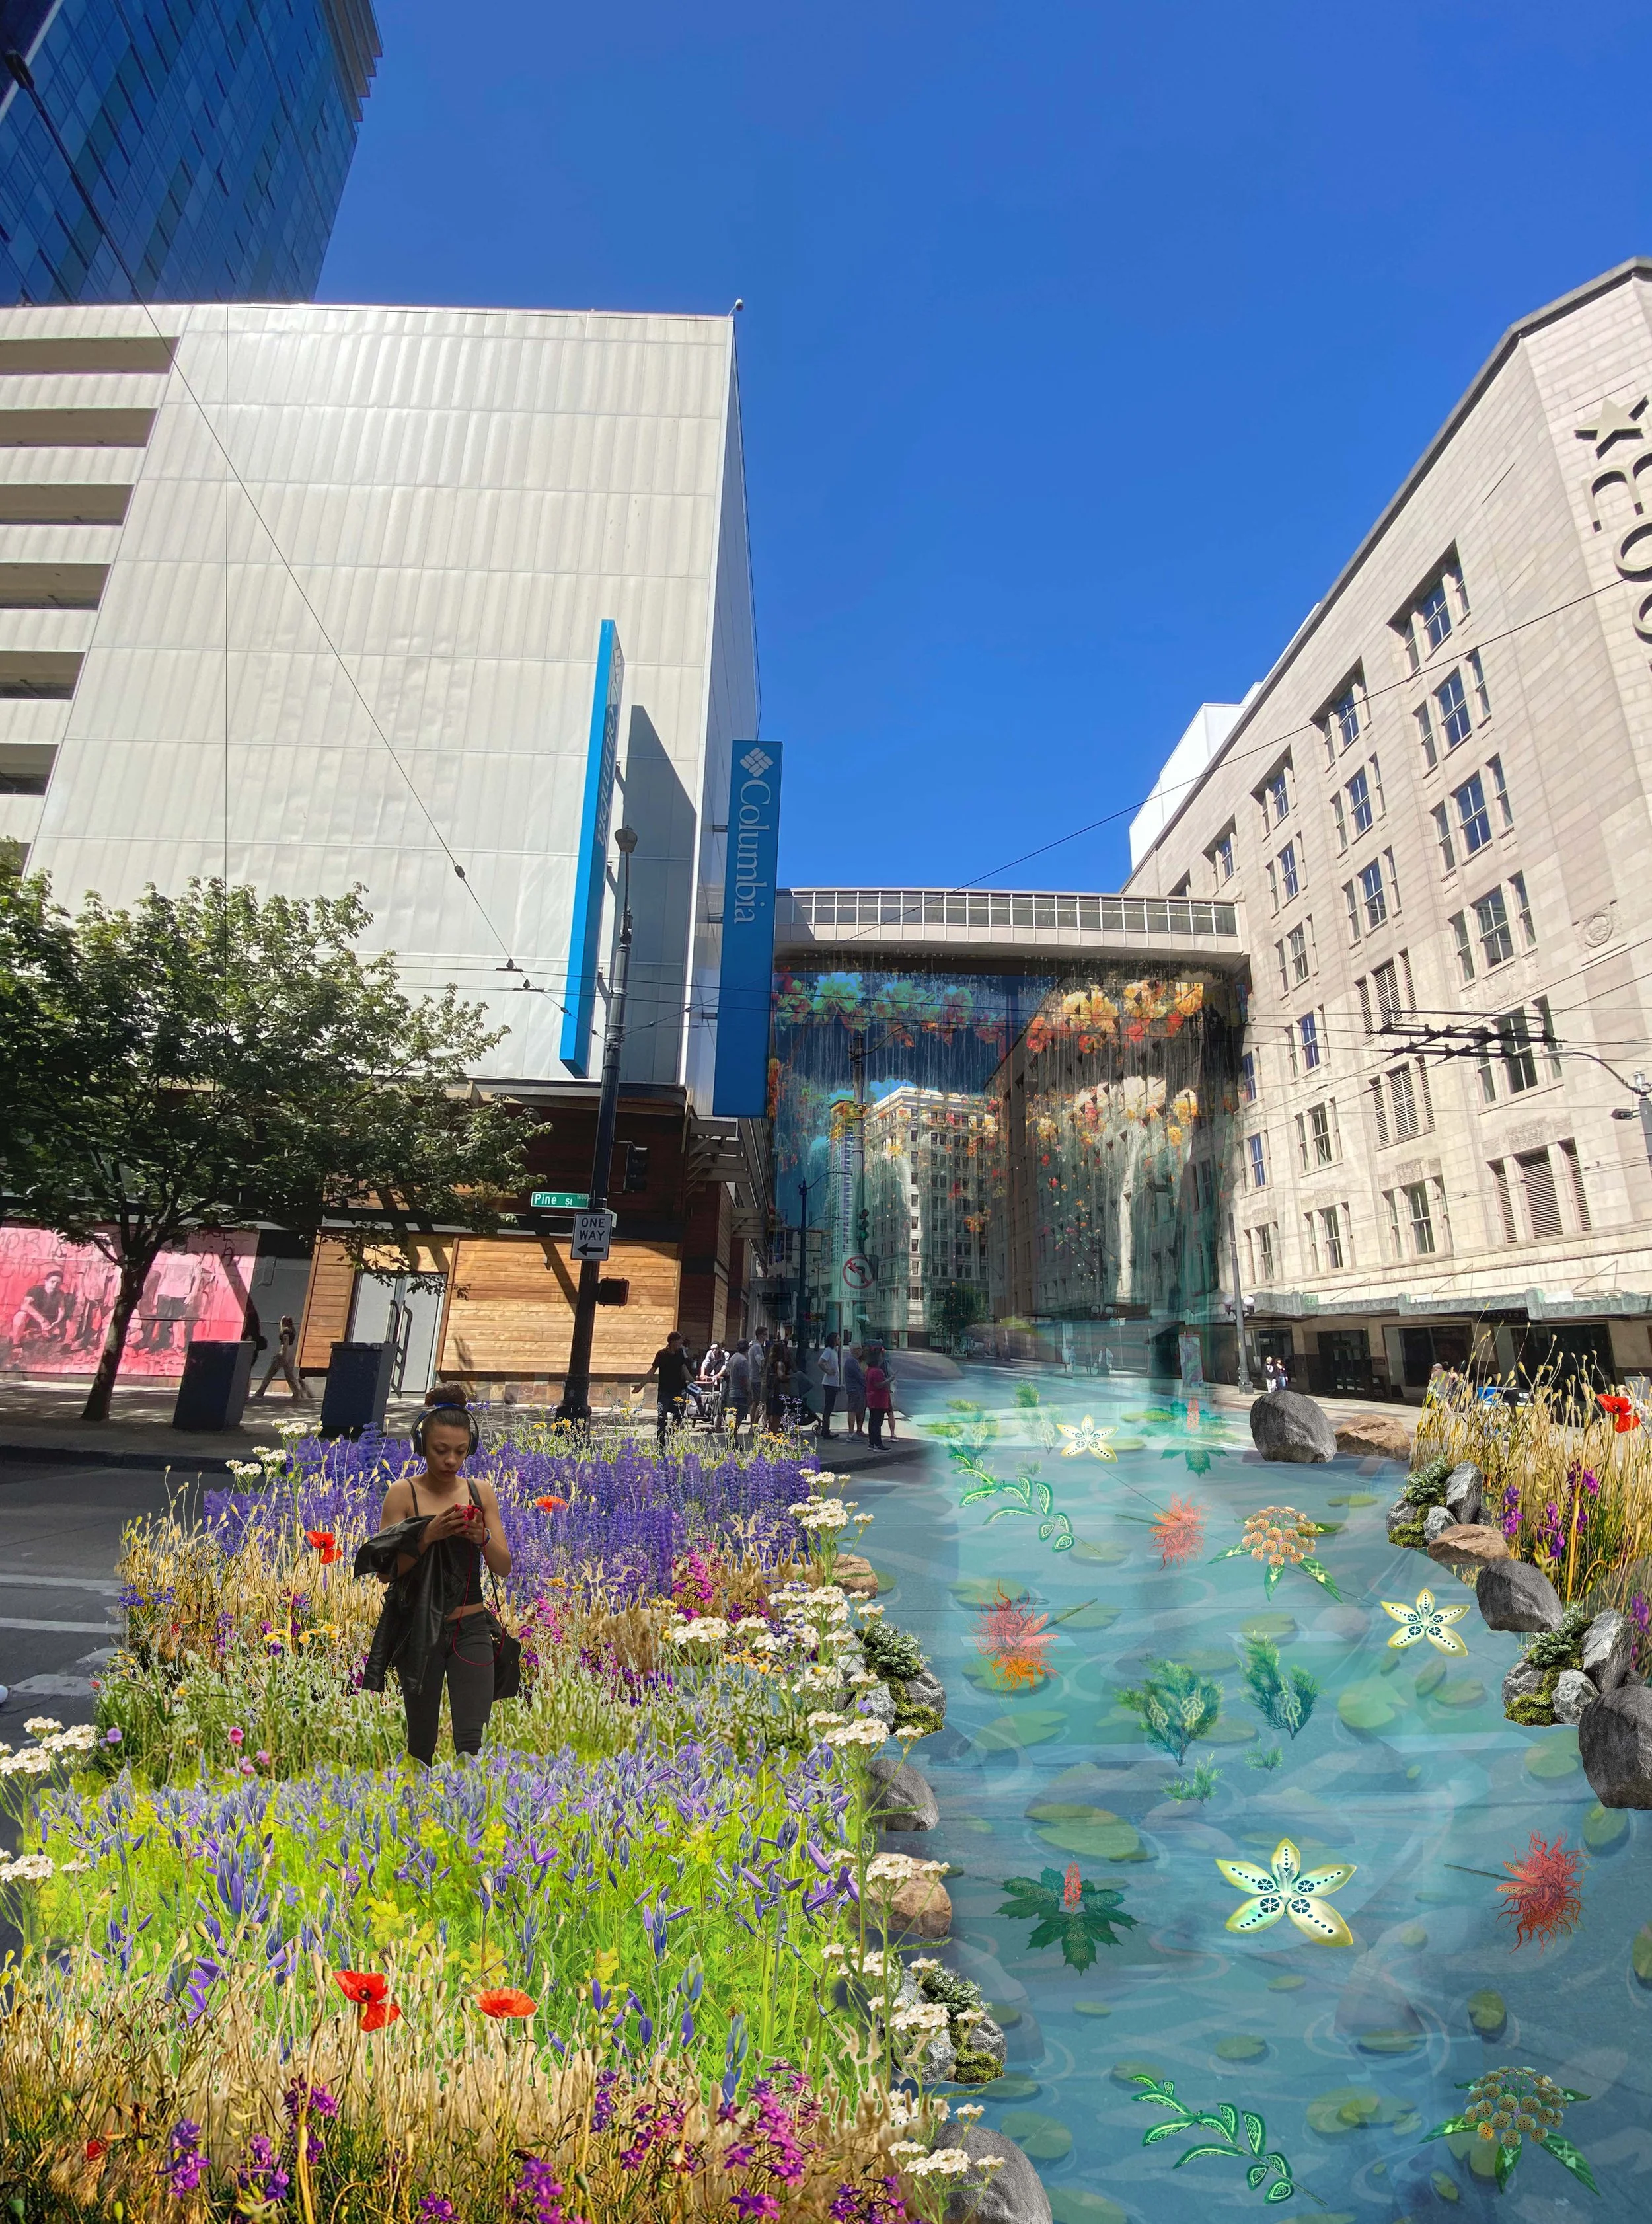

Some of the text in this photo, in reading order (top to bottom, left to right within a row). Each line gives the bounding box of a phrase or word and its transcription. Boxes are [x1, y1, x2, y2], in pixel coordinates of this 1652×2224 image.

[597, 679, 619, 849] Columbia
[733, 778, 772, 925] Columbia
[534, 1194, 557, 1205] Pine
[581, 1217, 606, 1229] ONE
[580, 1230, 605, 1241] WAY
